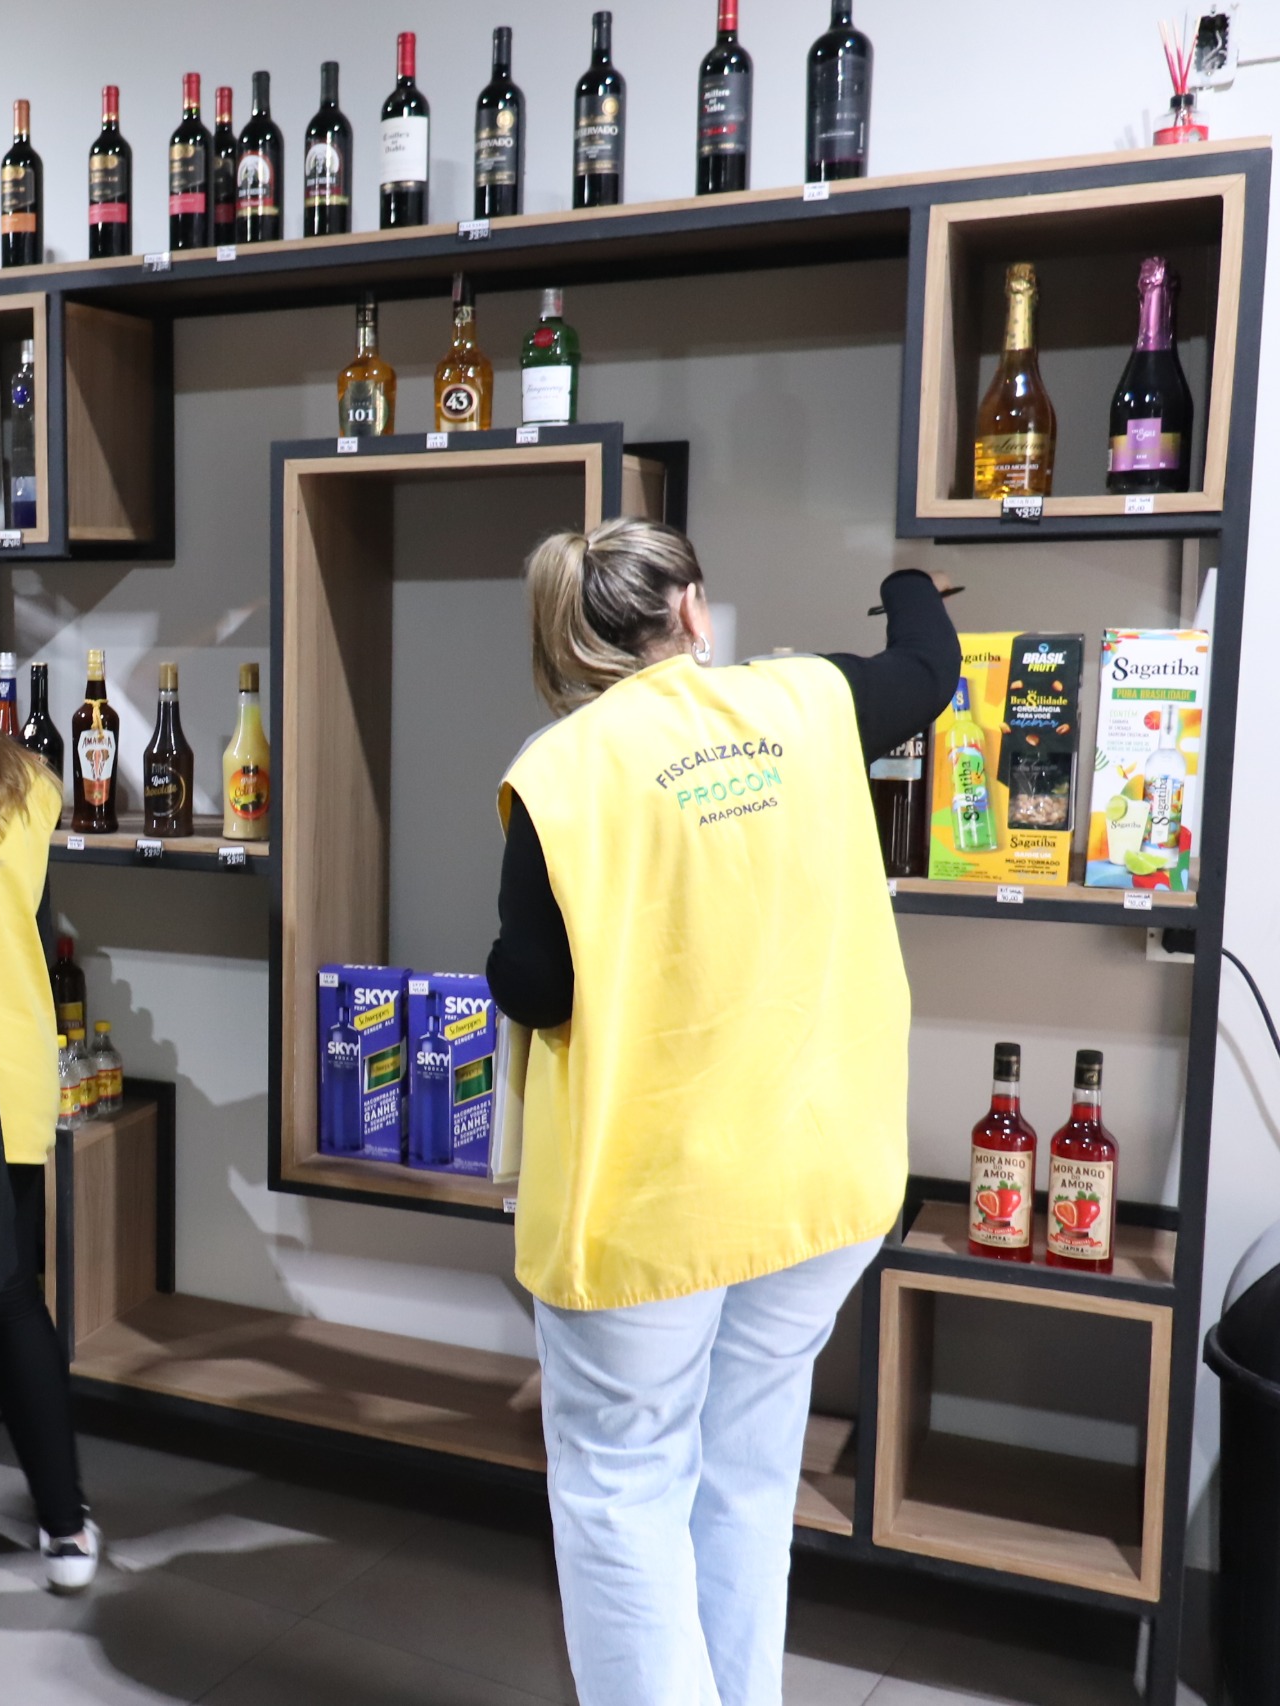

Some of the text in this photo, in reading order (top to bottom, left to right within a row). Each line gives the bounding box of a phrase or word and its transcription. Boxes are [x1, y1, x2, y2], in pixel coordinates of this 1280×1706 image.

[445, 392, 469, 411] 43
[348, 408, 375, 422] 101
[1022, 652, 1065, 665] BRASIL
[1028, 663, 1058, 673] FRUTT
[1111, 657, 1199, 681] Sagatiba
[1116, 688, 1191, 700] PURA BRASILIDADE
[655, 737, 783, 790] FISCALIZAÇÃO
[677, 766, 782, 810] PROCON
[959, 760, 980, 821] Sagatiba
[1151, 778, 1170, 826] Sagatiba
[699, 797, 778, 826] ARAPONGAS
[1110, 820, 1141, 830] Sagatiba
[1010, 837, 1056, 849] Sagatiba
[1027, 858, 1060, 866] TORRADO
[354, 988, 399, 1005] SKYY
[445, 996, 492, 1014] SKYY
[327, 1041, 360, 1056] SKYY
[416, 1051, 450, 1066] SKYY
[364, 1101, 397, 1122] GANHE
[454, 1113, 488, 1135] GANHE
[975, 1154, 1026, 1169] MORANGO
[983, 1169, 1014, 1181] AMOR
[1053, 1163, 1105, 1180] MORANGO
[1060, 1179, 1093, 1192] AMOR
